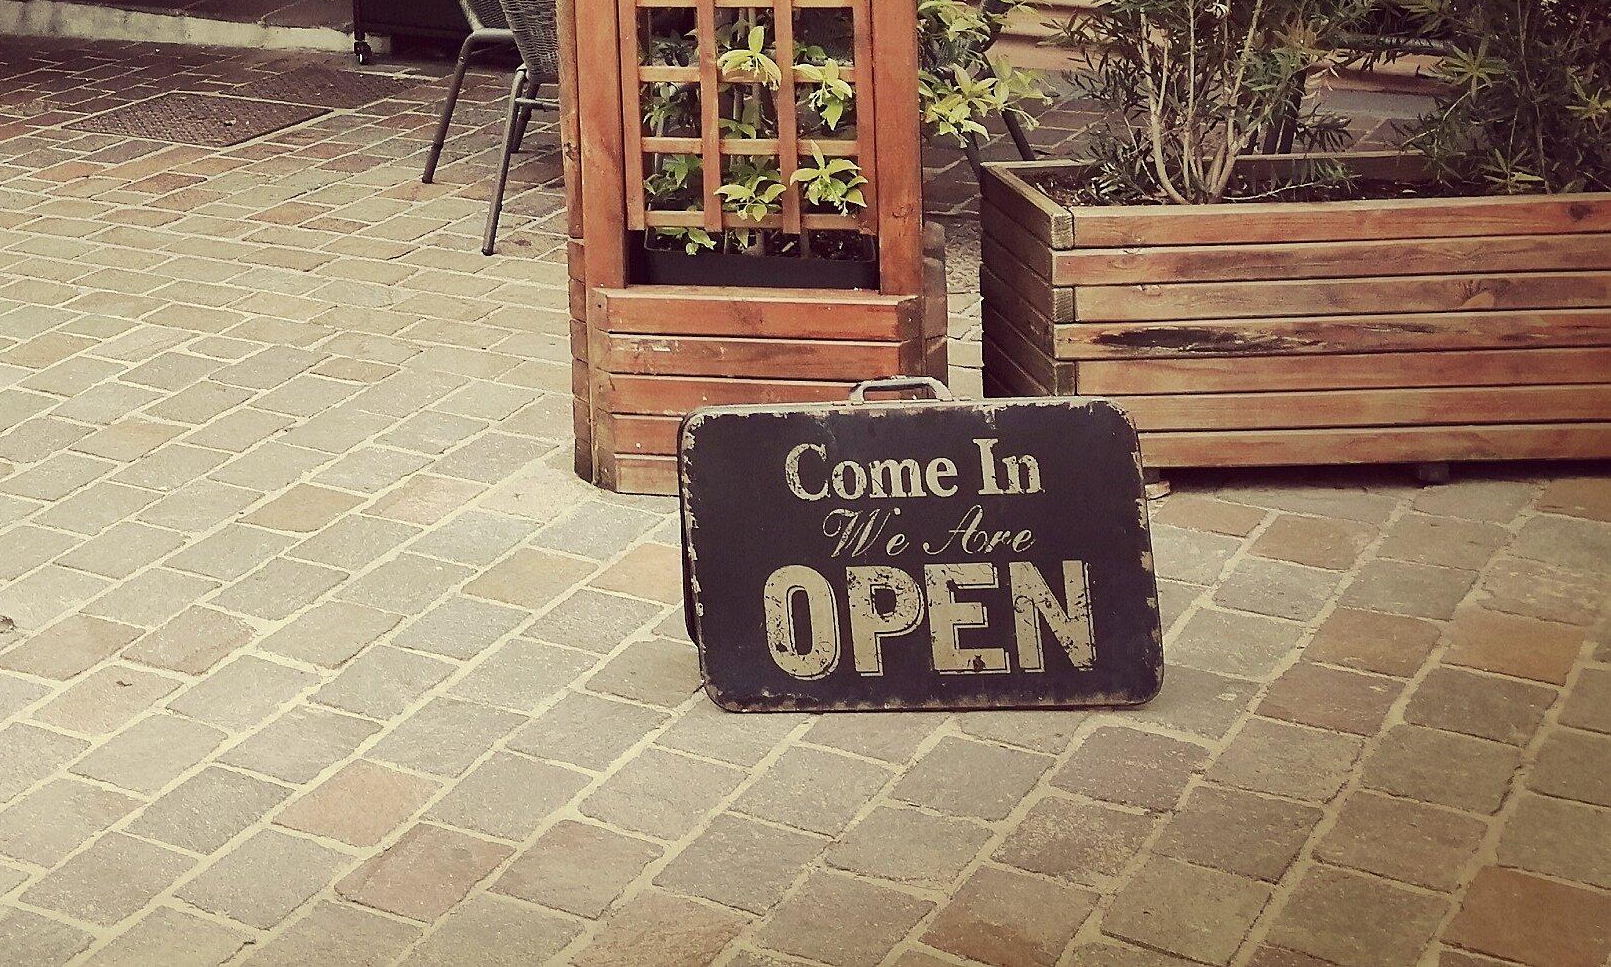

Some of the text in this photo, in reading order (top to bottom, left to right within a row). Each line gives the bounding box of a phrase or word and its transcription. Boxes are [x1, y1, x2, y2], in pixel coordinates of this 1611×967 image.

[785, 437, 1042, 502] Come In
[822, 504, 1037, 559] We Are
[763, 559, 1098, 682] OPEN
